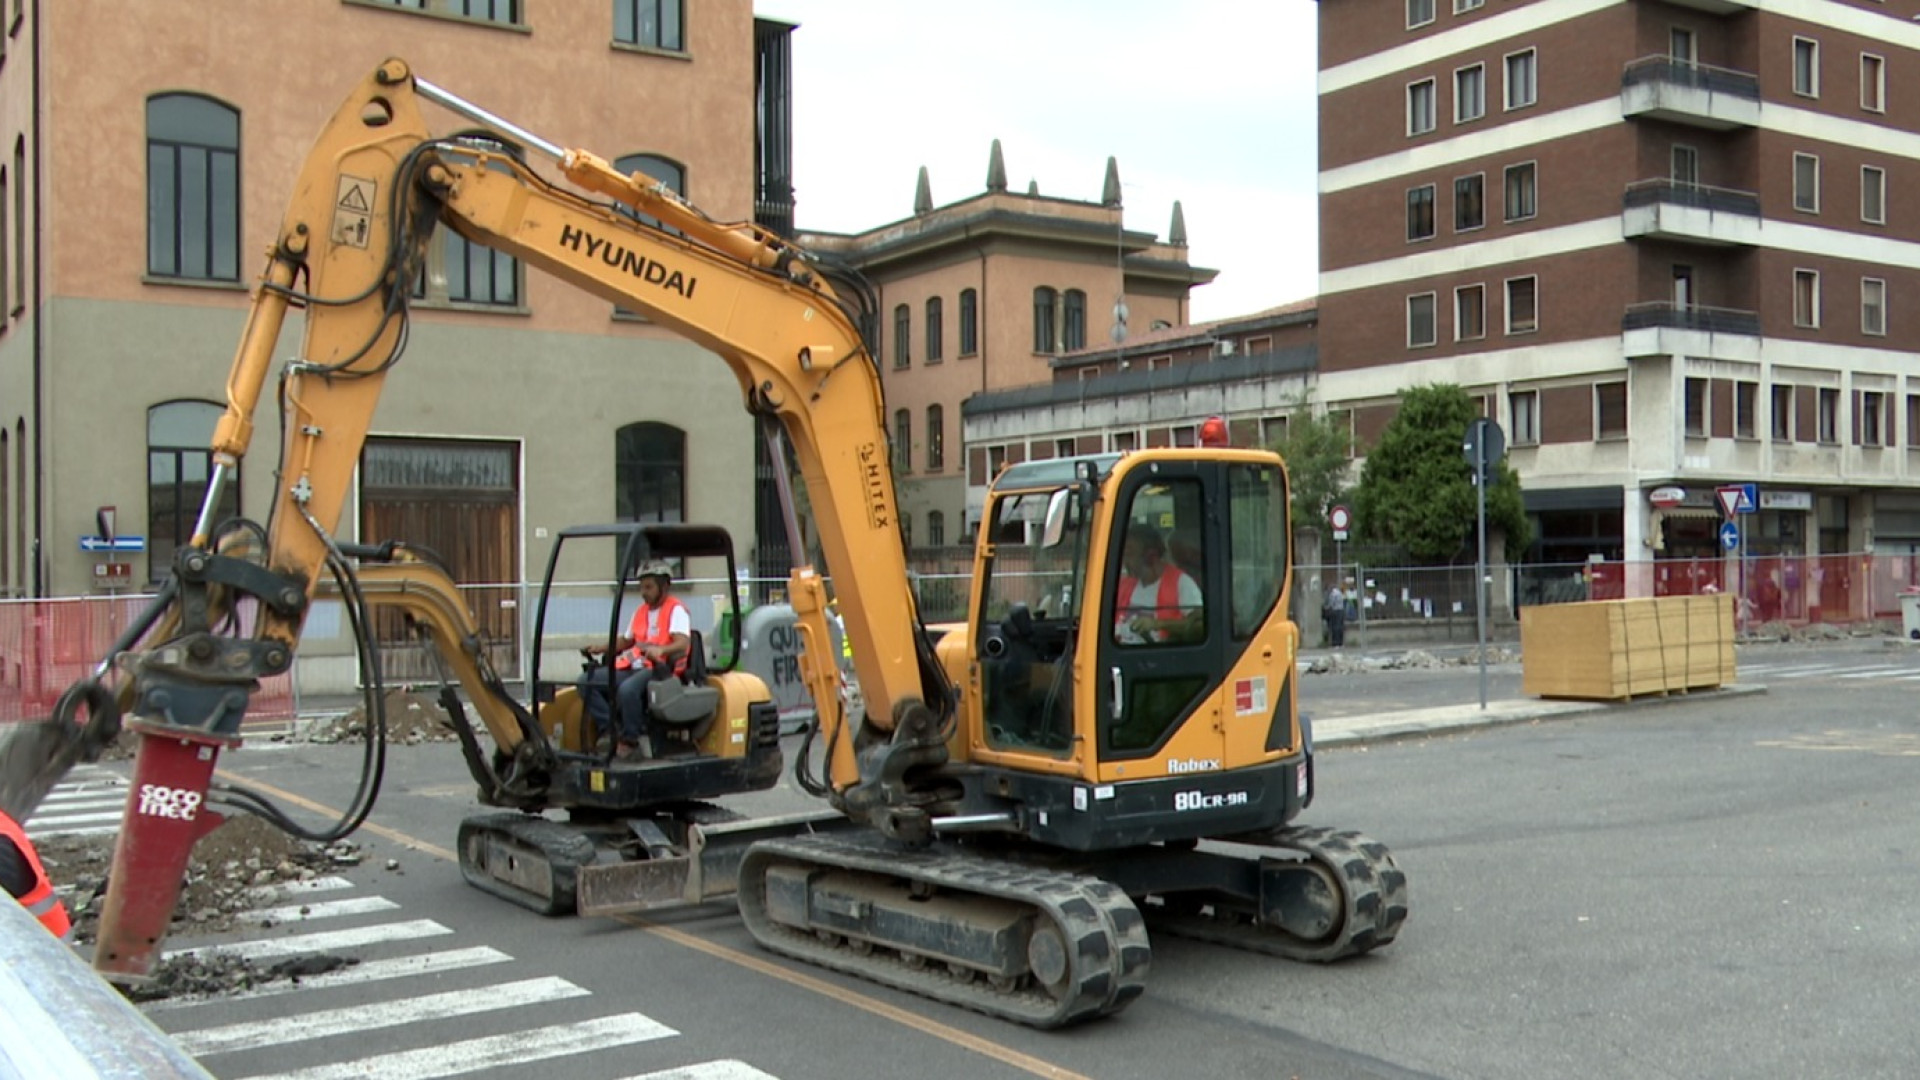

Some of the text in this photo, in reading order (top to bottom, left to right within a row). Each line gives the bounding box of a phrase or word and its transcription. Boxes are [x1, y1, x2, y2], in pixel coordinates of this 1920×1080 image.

[560, 224, 696, 299] HYUNDAI
[769, 625, 804, 652] QUI
[1168, 758, 1219, 774] Robex
